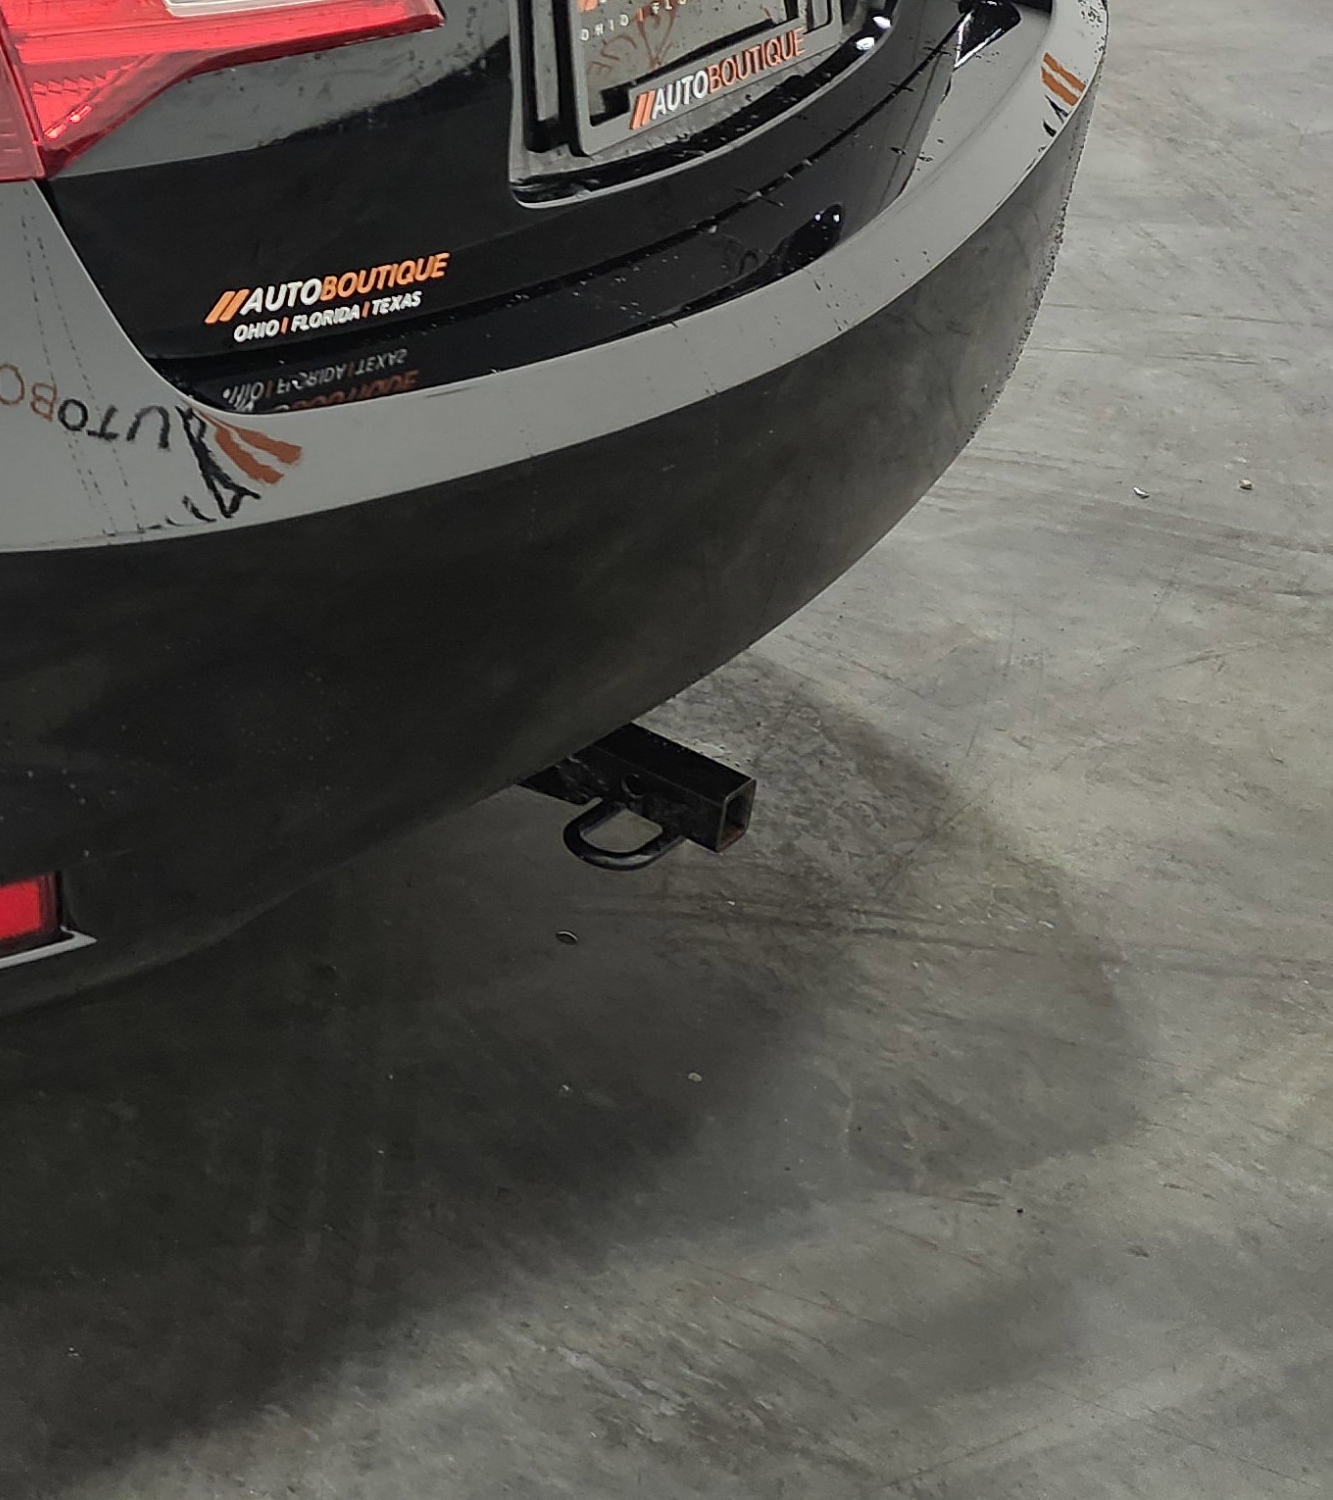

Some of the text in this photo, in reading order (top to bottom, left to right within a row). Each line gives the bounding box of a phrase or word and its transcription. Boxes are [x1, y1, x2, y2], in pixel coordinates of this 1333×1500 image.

[580, 13, 630, 42] OHIO
[651, 26, 807, 120] AUTOBOUTIQUE
[239, 252, 451, 316] AUTOBOUTIQUE
[233, 290, 423, 343] OHIO FLORIDA TEXAS
